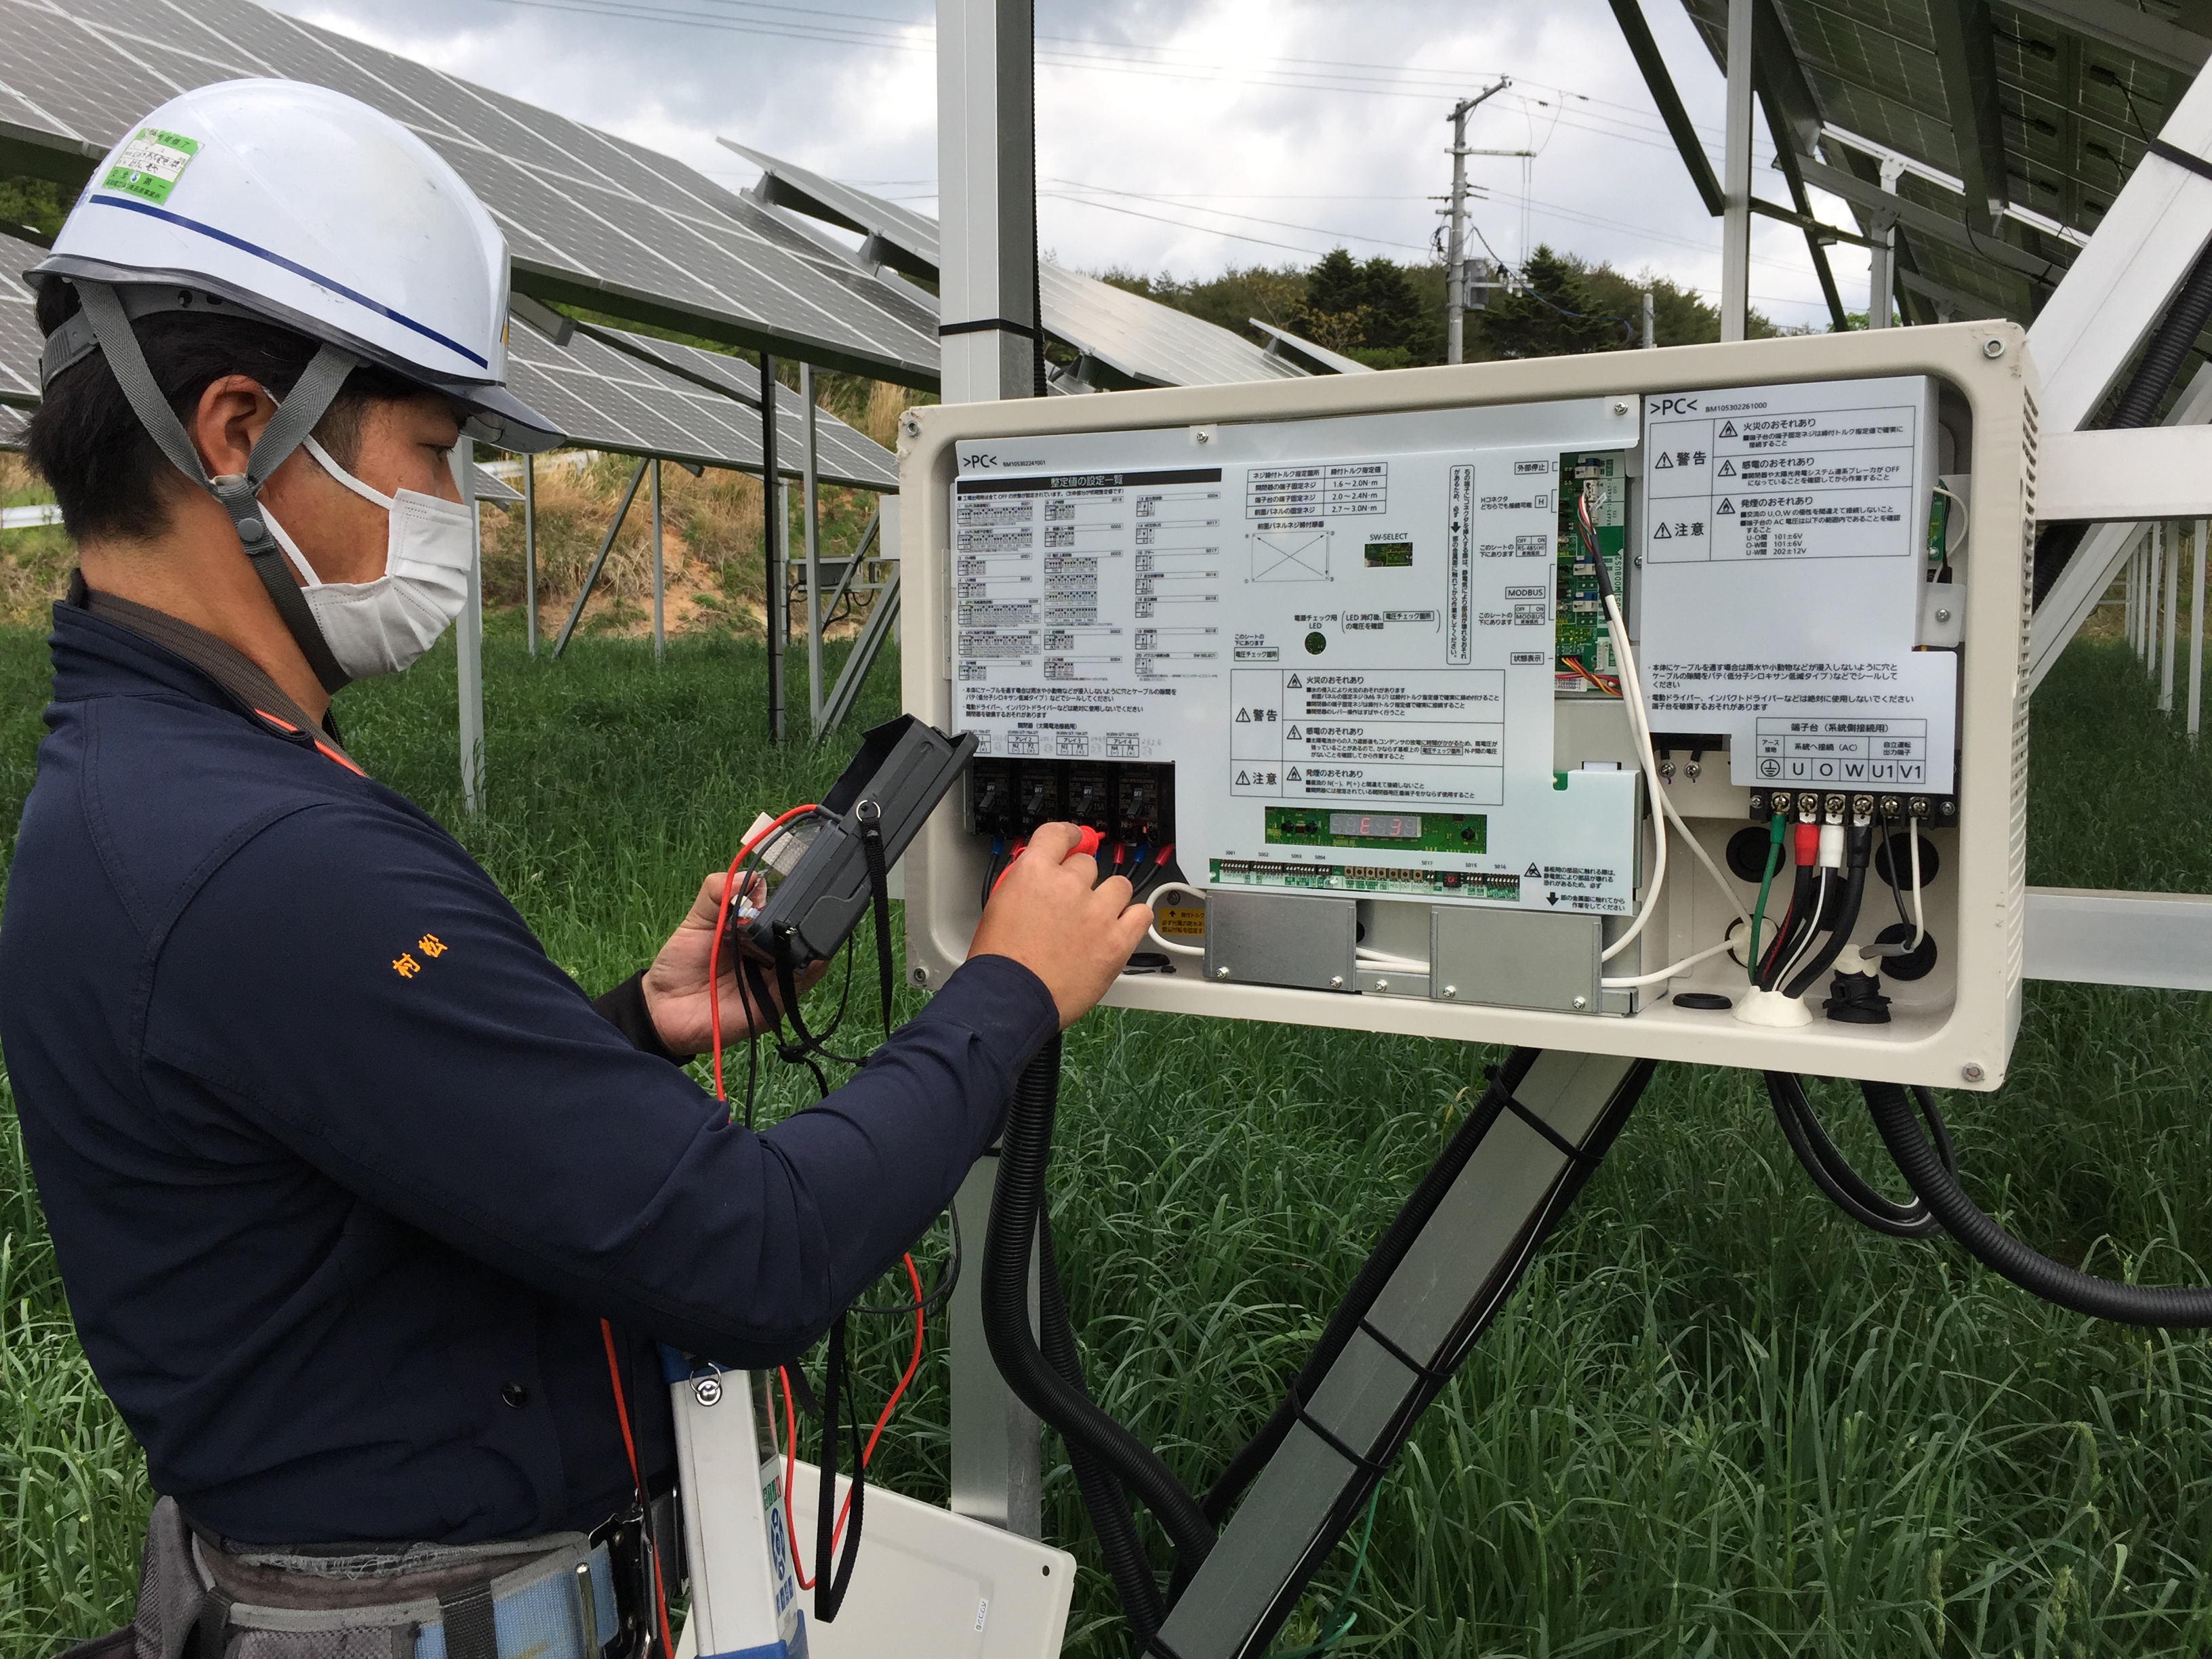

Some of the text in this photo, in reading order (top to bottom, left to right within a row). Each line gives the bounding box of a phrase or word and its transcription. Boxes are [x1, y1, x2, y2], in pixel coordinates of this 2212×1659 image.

[1743, 419, 1816, 431] 火災のおそれあり
[1677, 451, 1706, 466] 警告
[1742, 457, 1814, 469] 感電のおそれあり
[1517, 464, 1544, 472] 外部停止
[1051, 474, 1123, 487] 整定値の設定一覧
[1741, 497, 1813, 508] 発煙のおそれあり
[1675, 522, 1704, 536] 注意
[1253, 709, 1277, 721] 警告
[1306, 769, 1363, 777] 発煙のおそれあり
[1793, 762, 1921, 779] U O W U1 V1
[1253, 773, 1277, 785] 注意
